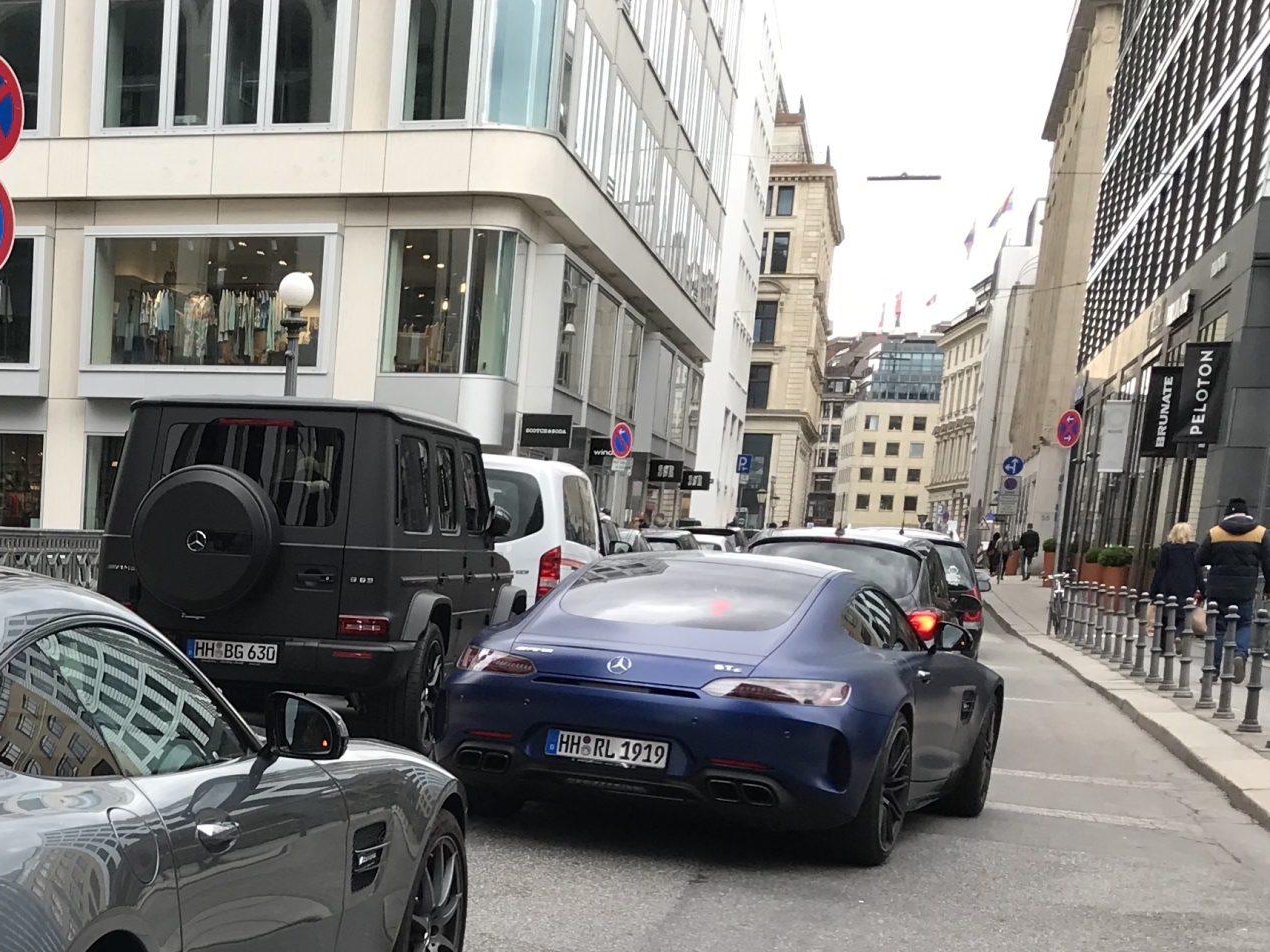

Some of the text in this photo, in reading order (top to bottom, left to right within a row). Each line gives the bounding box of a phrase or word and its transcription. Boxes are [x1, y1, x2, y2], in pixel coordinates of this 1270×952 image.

[1154, 375, 1174, 448] BRUNATE
[1189, 350, 1215, 436] PELOTON
[195, 641, 215, 658] HH
[224, 643, 244, 660] BG
[247, 645, 276, 662] 630
[558, 734, 582, 755] HH
[593, 738, 616, 759] RL
[619, 741, 665, 765] 1919
